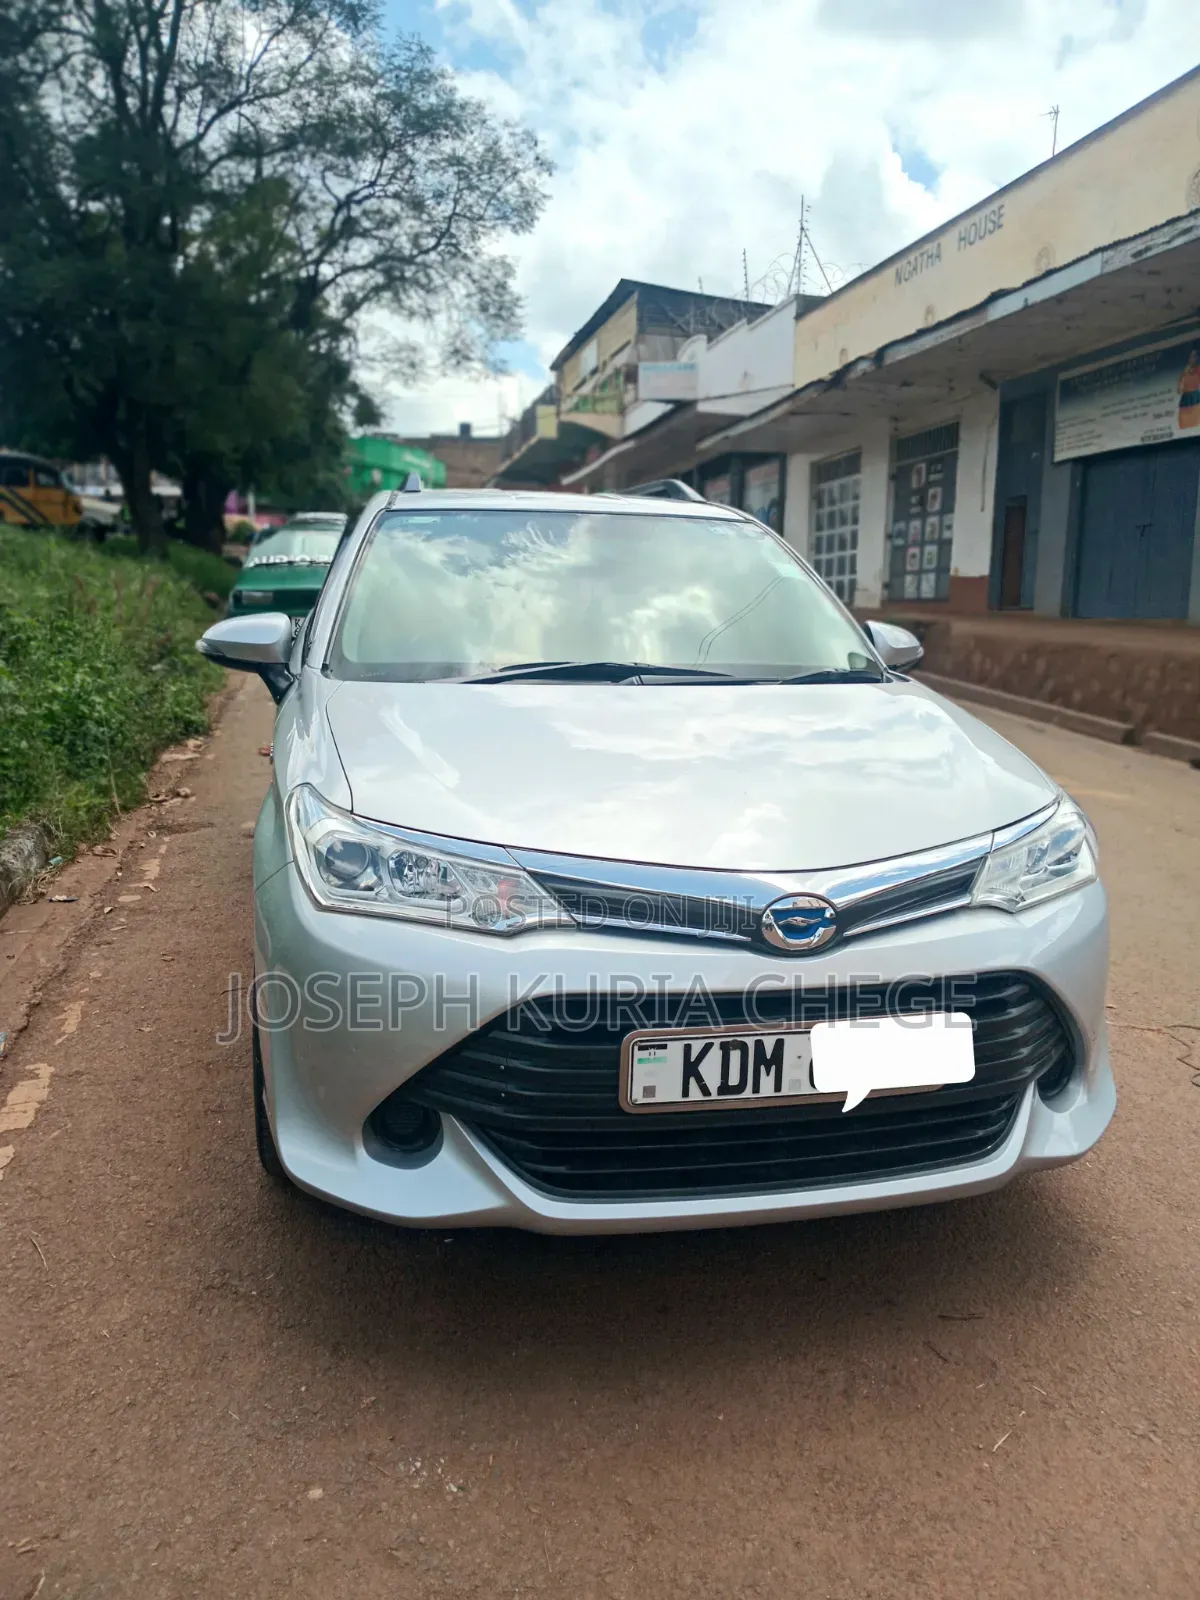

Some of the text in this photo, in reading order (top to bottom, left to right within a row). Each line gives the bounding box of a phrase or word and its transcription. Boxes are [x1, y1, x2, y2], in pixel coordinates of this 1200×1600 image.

[895, 203, 1005, 287] NGATHA HOUSE
[681, 1037, 785, 1098] KDM
